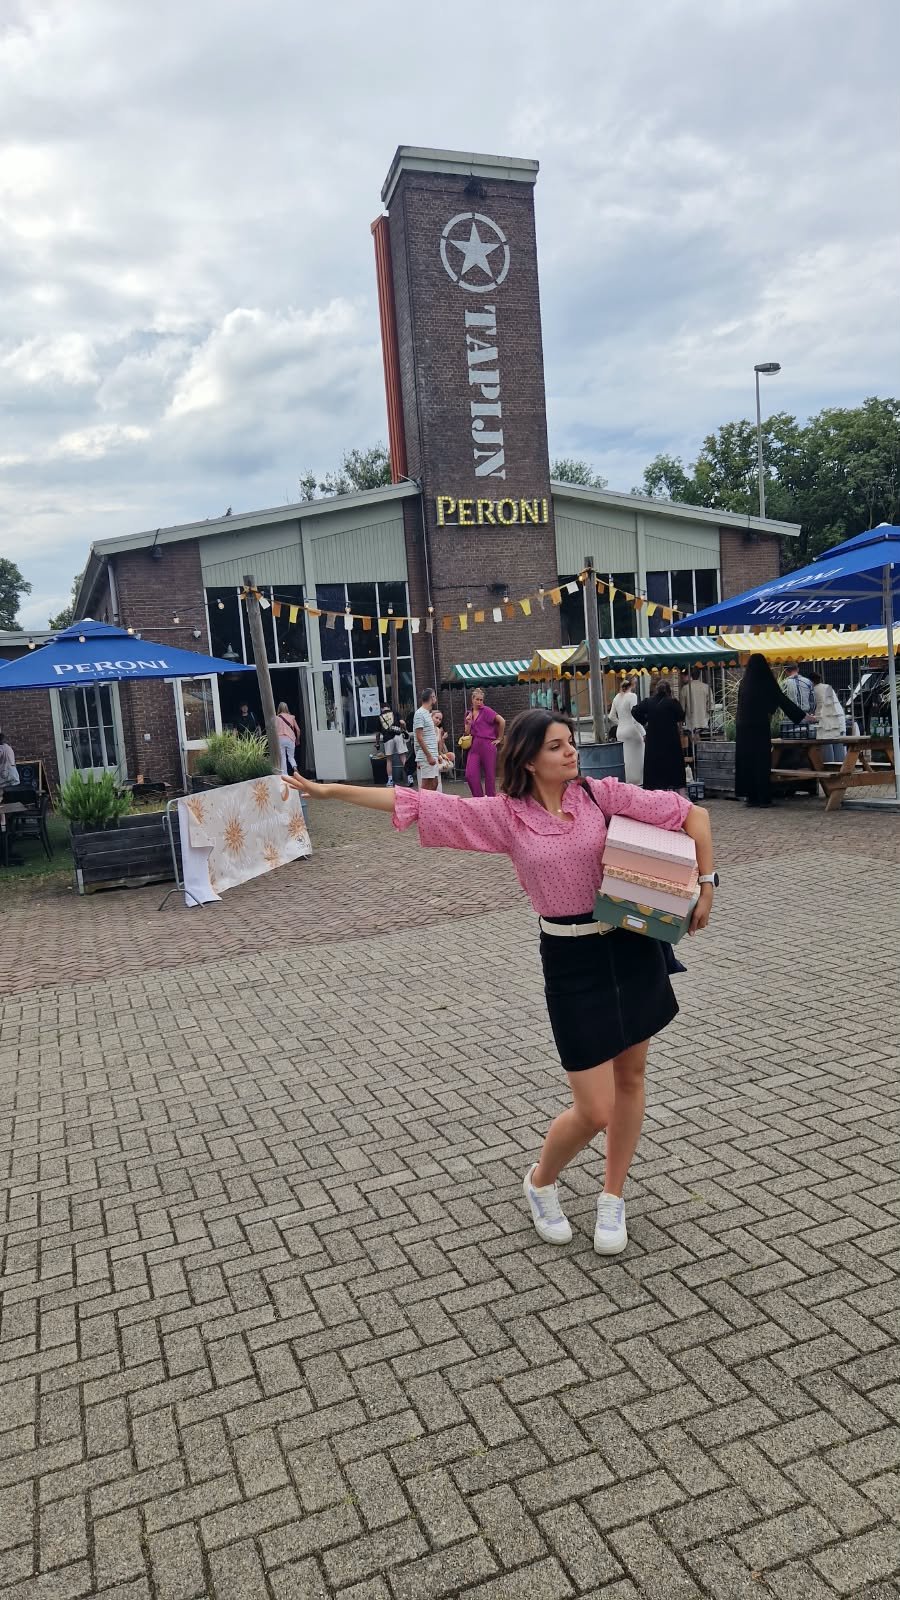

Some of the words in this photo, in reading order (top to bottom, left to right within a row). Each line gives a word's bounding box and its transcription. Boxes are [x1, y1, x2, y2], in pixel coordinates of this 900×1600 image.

[465, 305, 506, 480] TAPIJN
[436, 495, 549, 525] PERONI
[52, 659, 170, 675] PERONI
